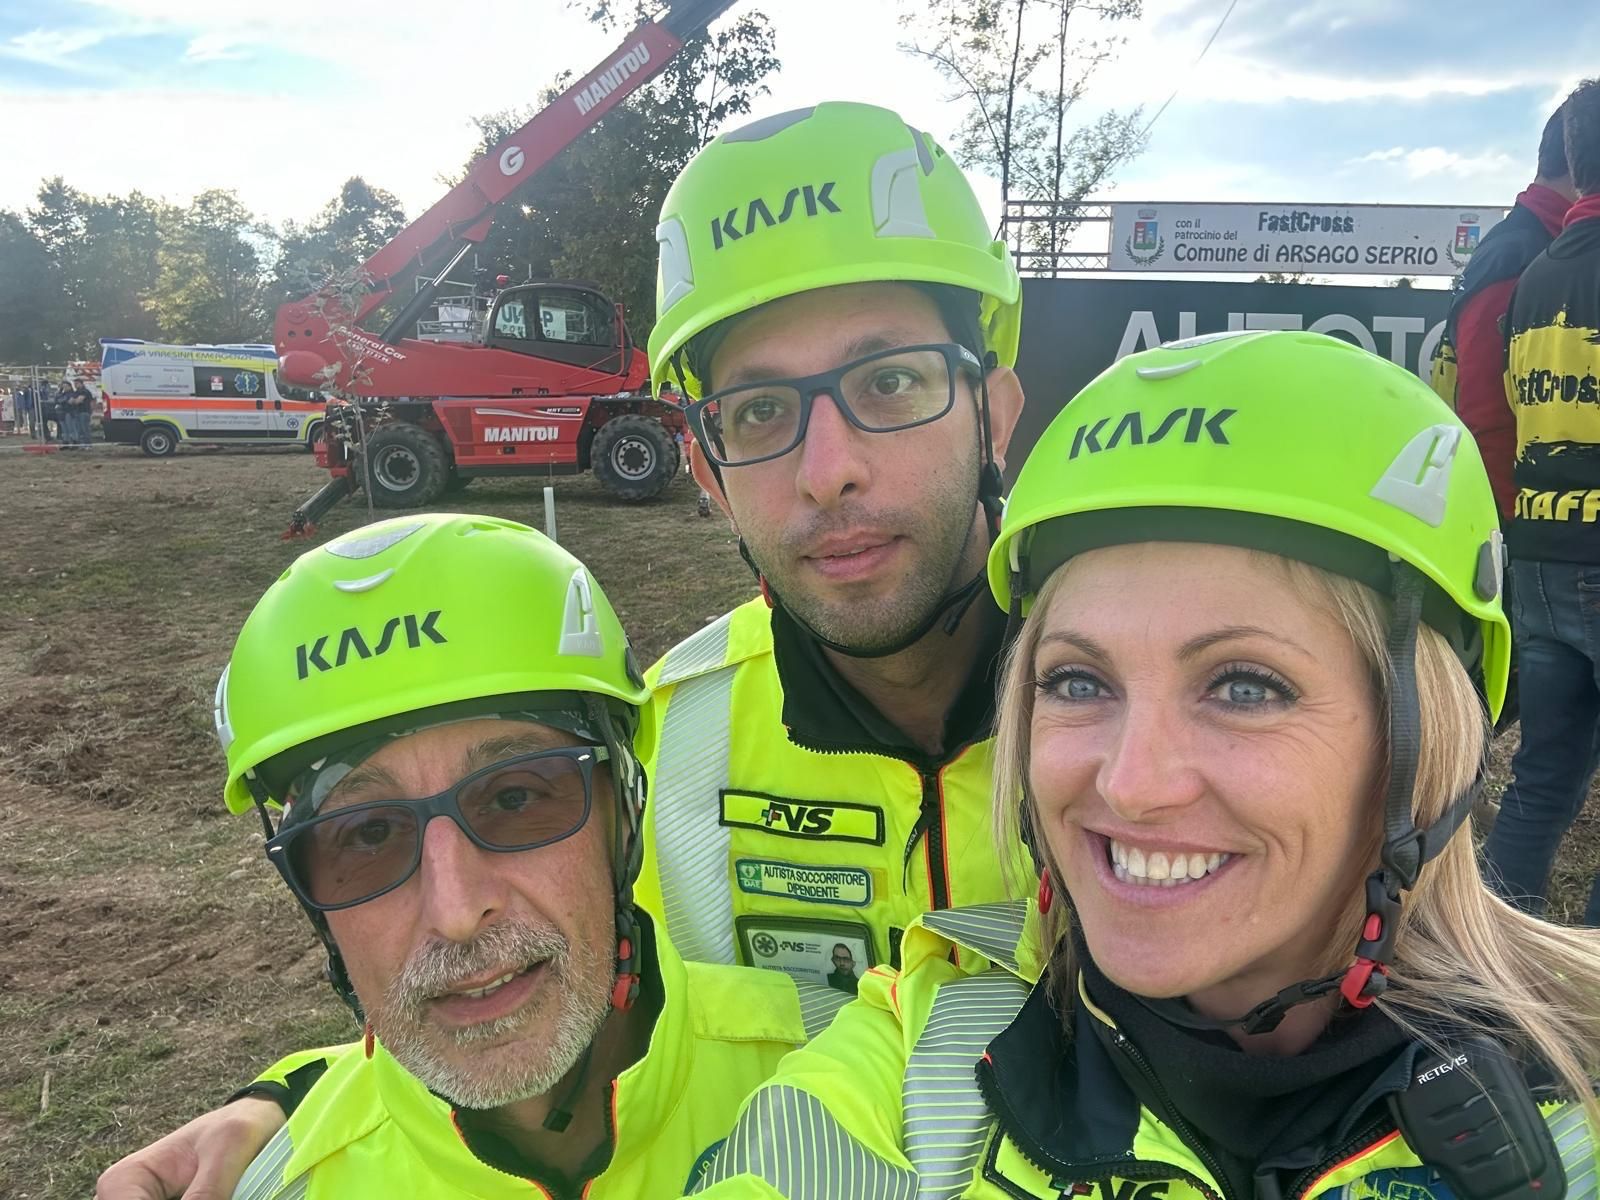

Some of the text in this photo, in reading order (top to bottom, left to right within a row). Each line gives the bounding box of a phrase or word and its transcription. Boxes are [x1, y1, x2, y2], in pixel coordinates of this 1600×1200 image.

[573, 42, 651, 116] MANITOU
[499, 146, 525, 176] G
[711, 181, 842, 251] KASK
[1175, 218, 1201, 228] con il
[1258, 210, 1354, 233] FastCross
[1174, 230, 1238, 240] patrocinio del
[1174, 243, 1438, 265] Comune di ARSAGO SEPRIO
[384, 346, 407, 360] Car
[1512, 367, 1600, 406] stCros
[484, 426, 560, 443] MANITOU
[1068, 407, 1238, 461] KASK
[296, 610, 448, 681] KASK
[764, 866, 865, 886] AUTISTA SOCCORRITORE
[786, 882, 840, 898] DIPENDENTE
[1416, 1054, 1468, 1085] RETEVIS
